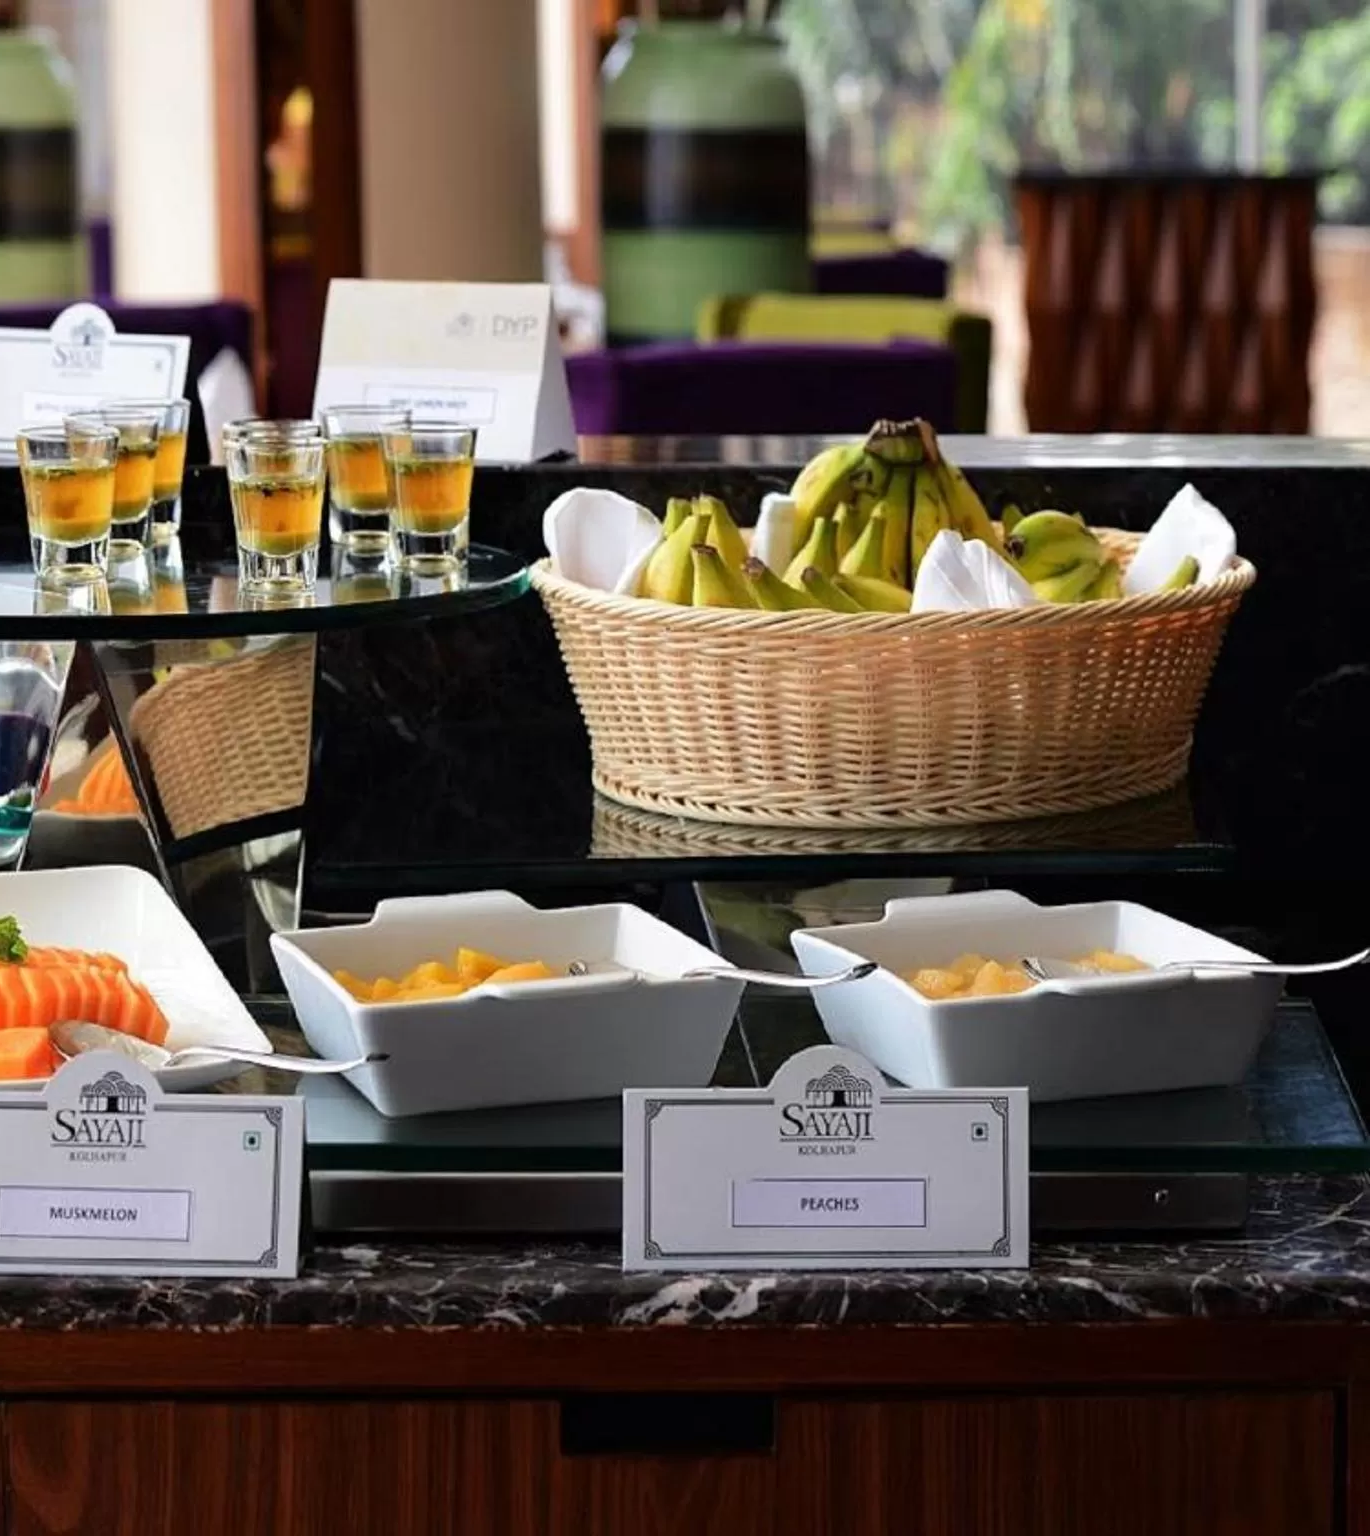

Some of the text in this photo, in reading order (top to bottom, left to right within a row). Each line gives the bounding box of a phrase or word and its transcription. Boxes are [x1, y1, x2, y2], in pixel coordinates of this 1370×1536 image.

[51, 1110, 146, 1148] SAYAJI
[780, 1104, 874, 1142] SAYAJI
[49, 1207, 138, 1222] MUSKMELON
[800, 1197, 860, 1212] PEACHES
